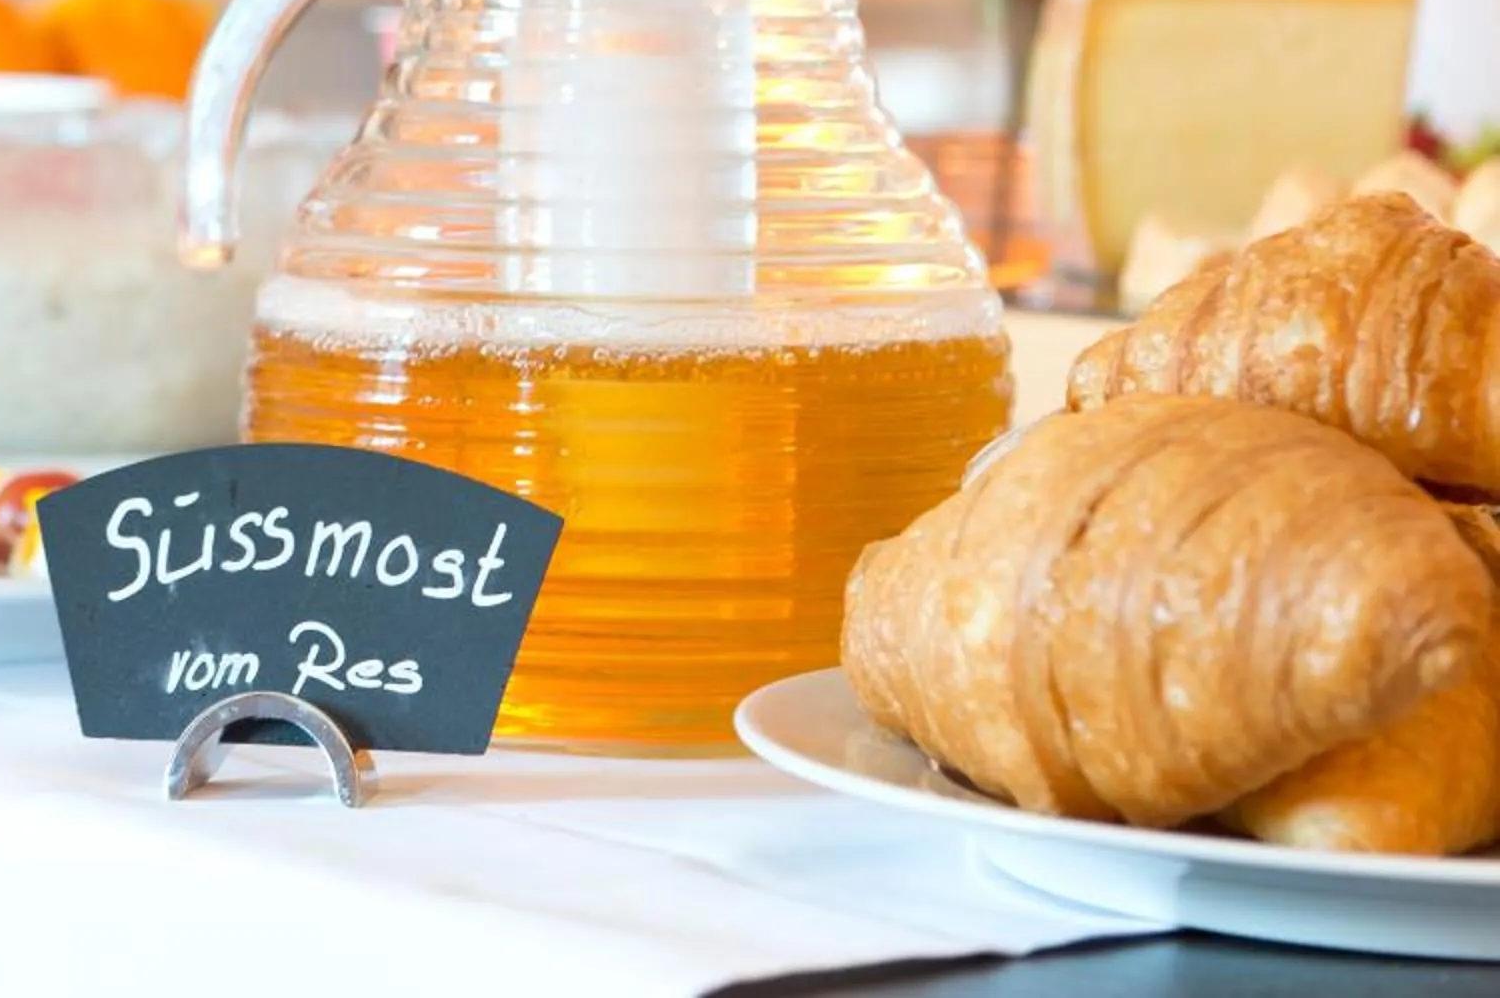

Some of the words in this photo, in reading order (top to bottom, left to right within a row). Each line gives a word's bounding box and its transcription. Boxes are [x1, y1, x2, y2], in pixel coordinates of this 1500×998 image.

[105, 491, 513, 607] Süssmost
[165, 649, 260, 694] vom
[288, 620, 424, 696] Res
